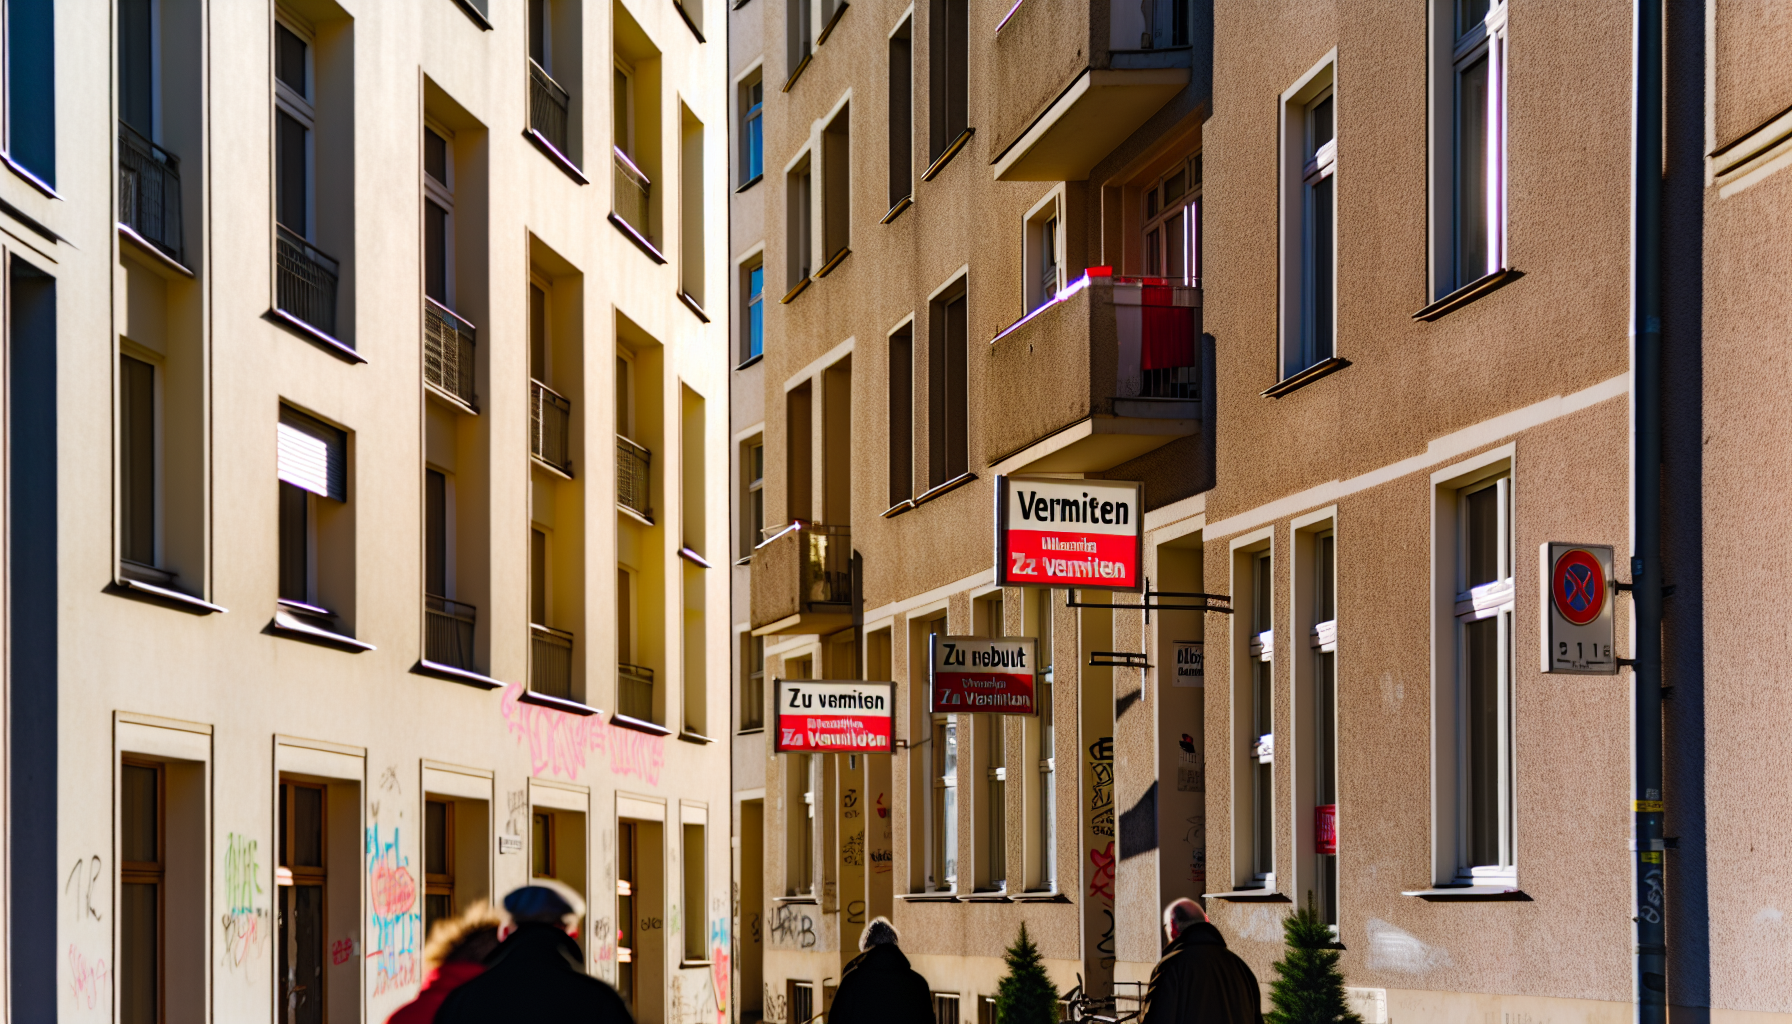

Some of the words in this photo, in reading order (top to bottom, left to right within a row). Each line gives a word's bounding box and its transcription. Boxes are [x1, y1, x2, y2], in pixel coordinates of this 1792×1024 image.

[1017, 490, 1129, 525] Vermiten
[942, 643, 966, 666] Zu
[787, 688, 812, 709] Zu
